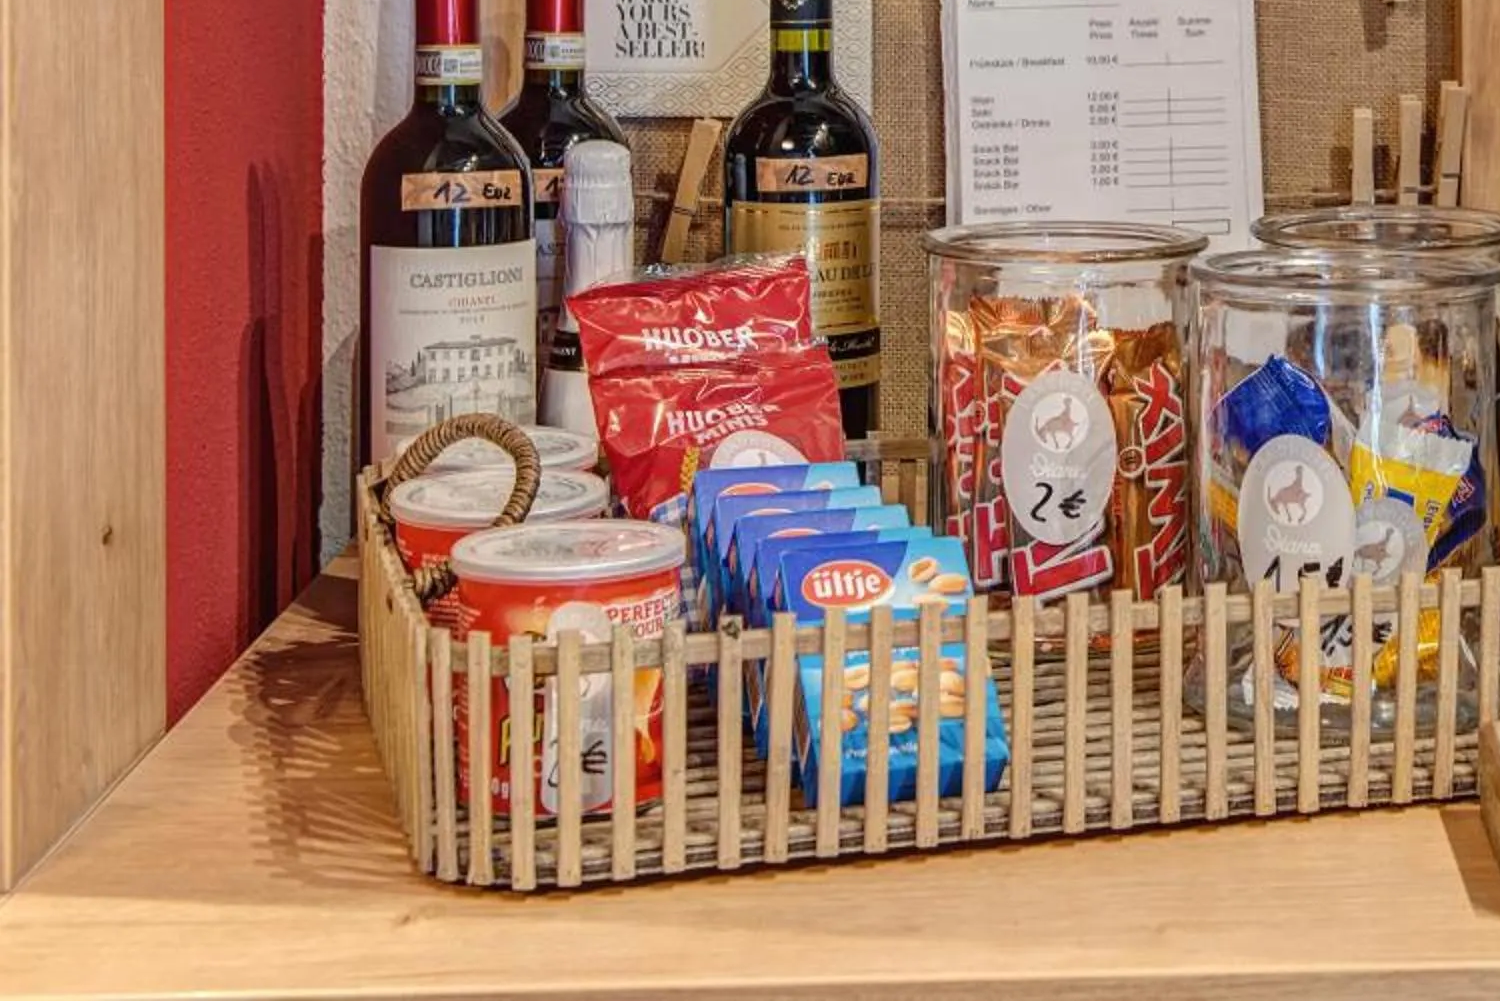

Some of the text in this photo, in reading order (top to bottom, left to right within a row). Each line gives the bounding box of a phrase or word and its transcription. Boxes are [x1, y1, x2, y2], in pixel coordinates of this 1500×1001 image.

[616, 3, 692, 21] YOURS
[619, 22, 629, 40] A
[615, 40, 705, 58] SELLER!
[545, 175, 564, 197] 1
[784, 164, 814, 186] 12
[433, 180, 471, 205] 12
[640, 322, 758, 352] HUOBER
[1030, 482, 1054, 523] 2
[813, 569, 884, 601] ültje
